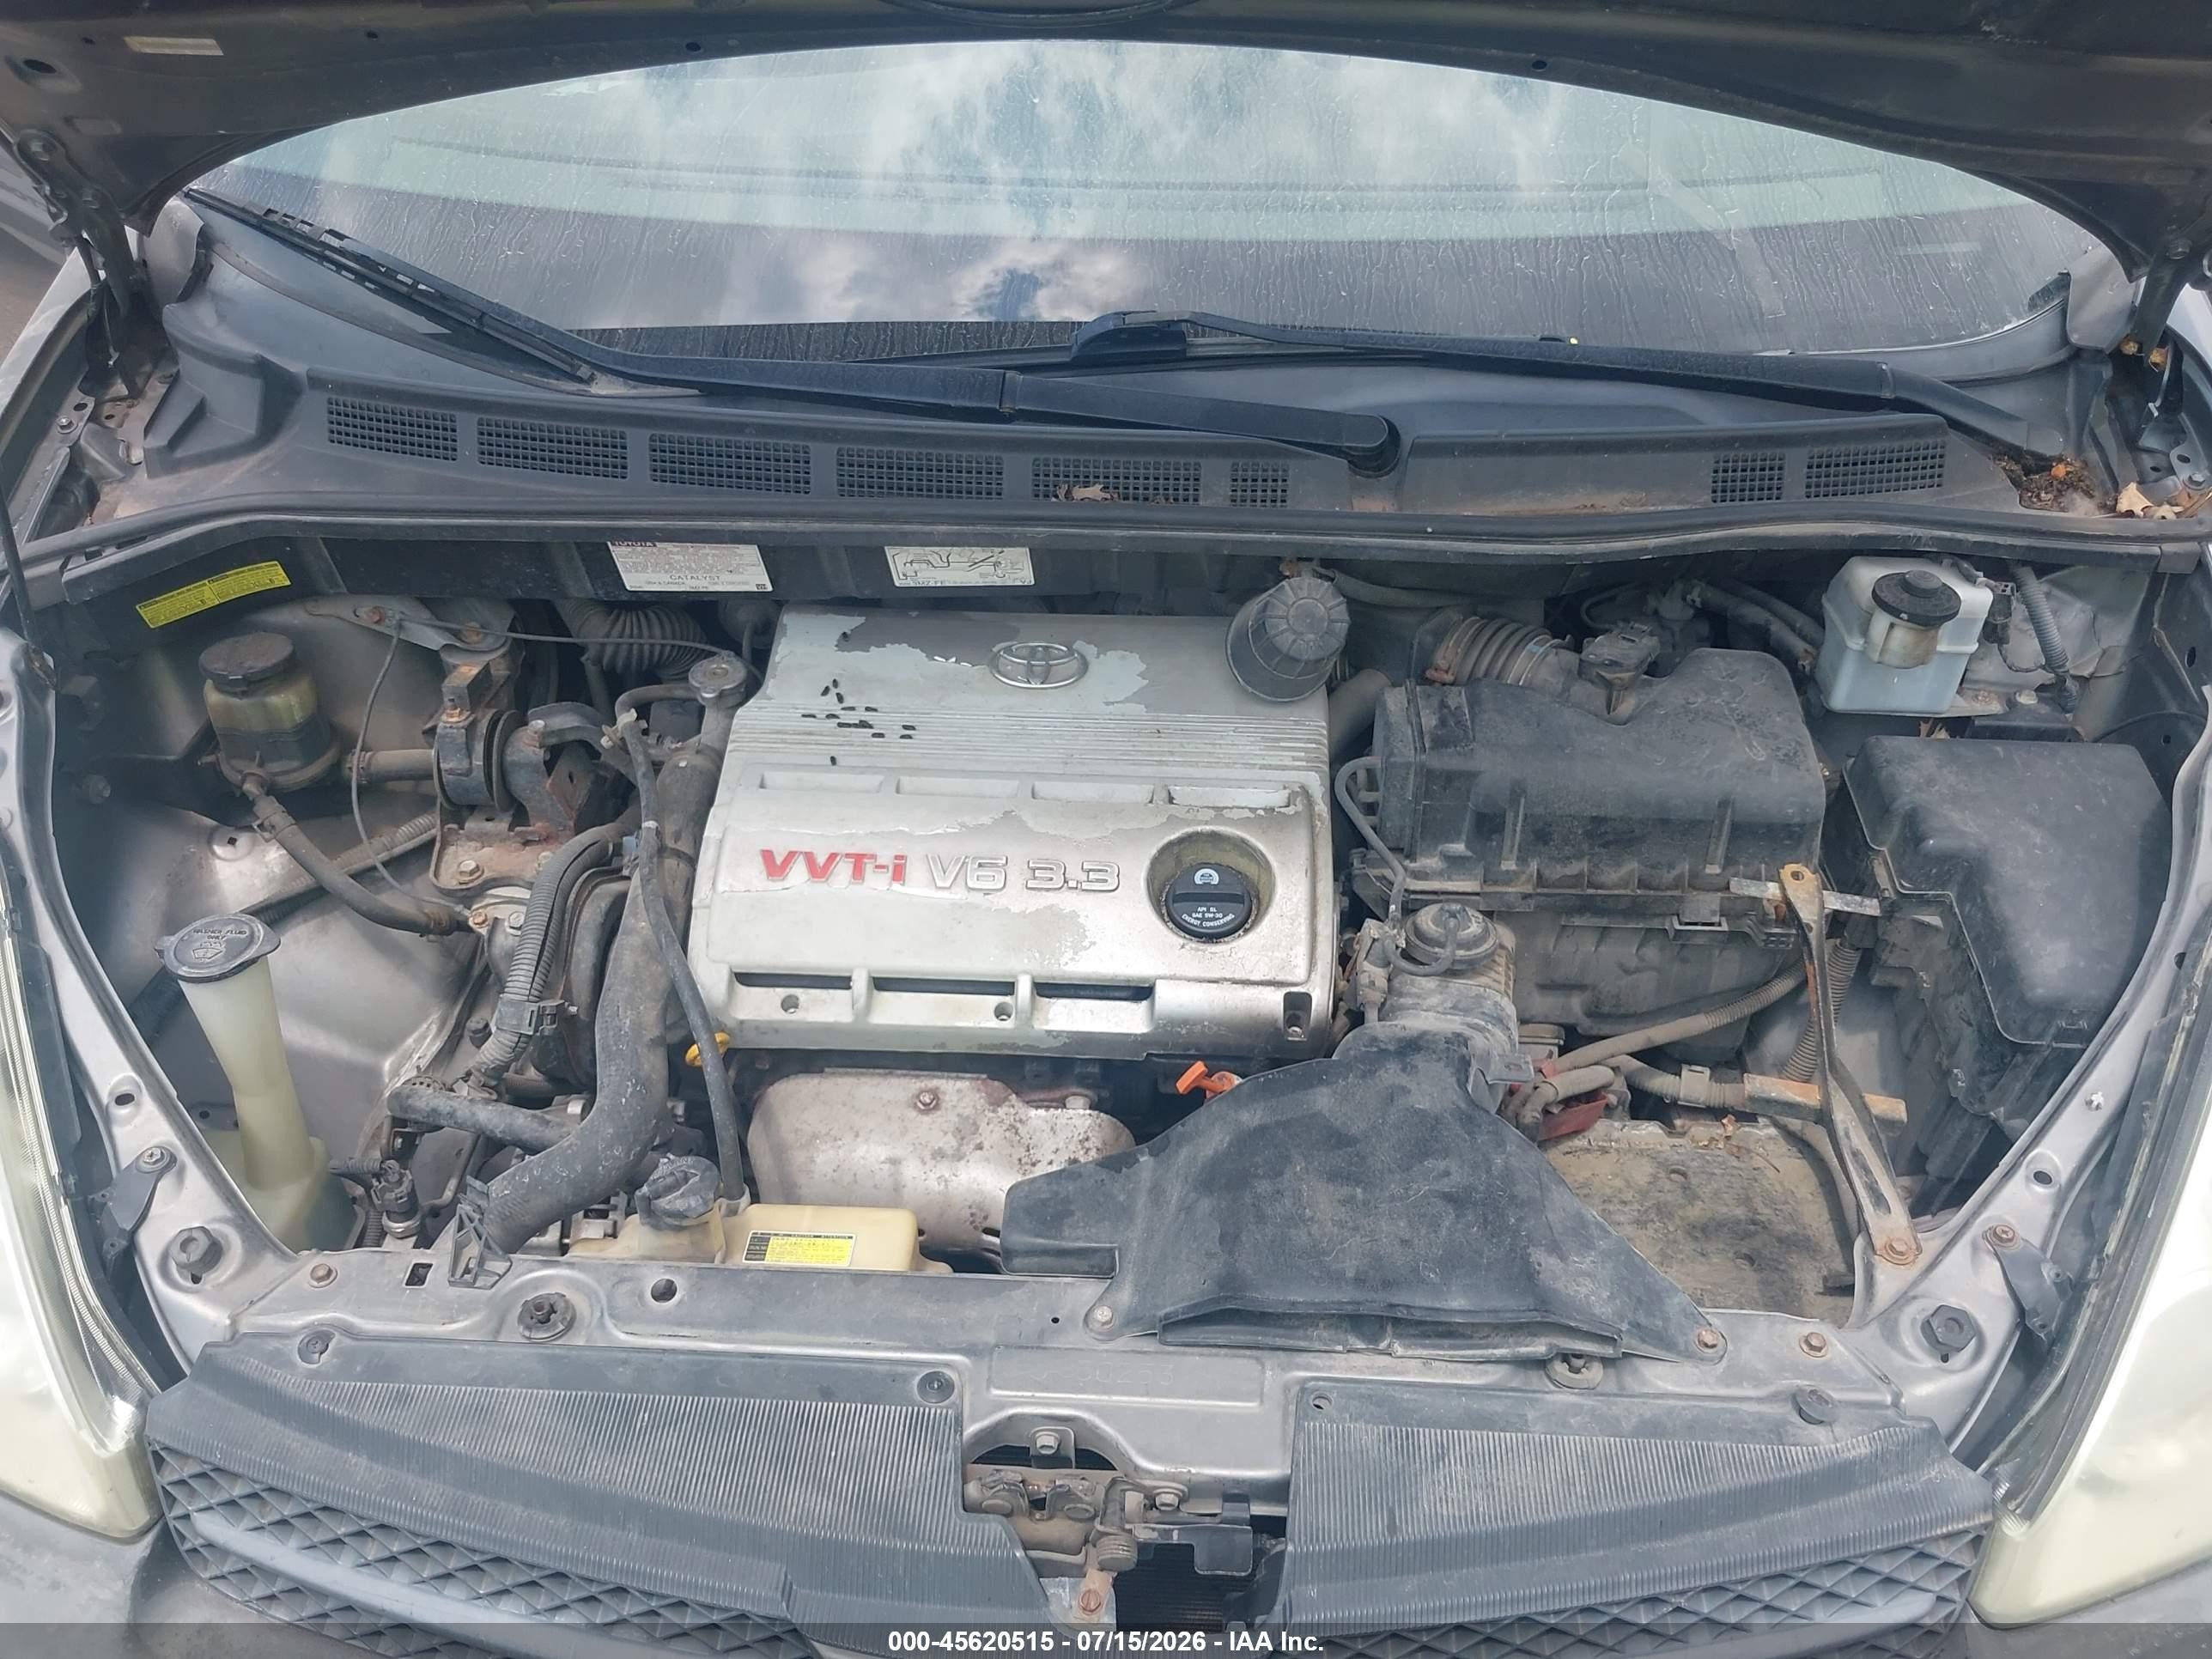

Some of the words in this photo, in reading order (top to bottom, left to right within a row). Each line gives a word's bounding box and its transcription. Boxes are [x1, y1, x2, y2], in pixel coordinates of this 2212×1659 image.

[760, 848, 908, 885] VVT-i
[927, 853, 1008, 891] V6
[1025, 858, 1121, 893] 3.3
[1182, 914, 1201, 926] ENERGY
[1202, 913, 1235, 927] CONSERVING
